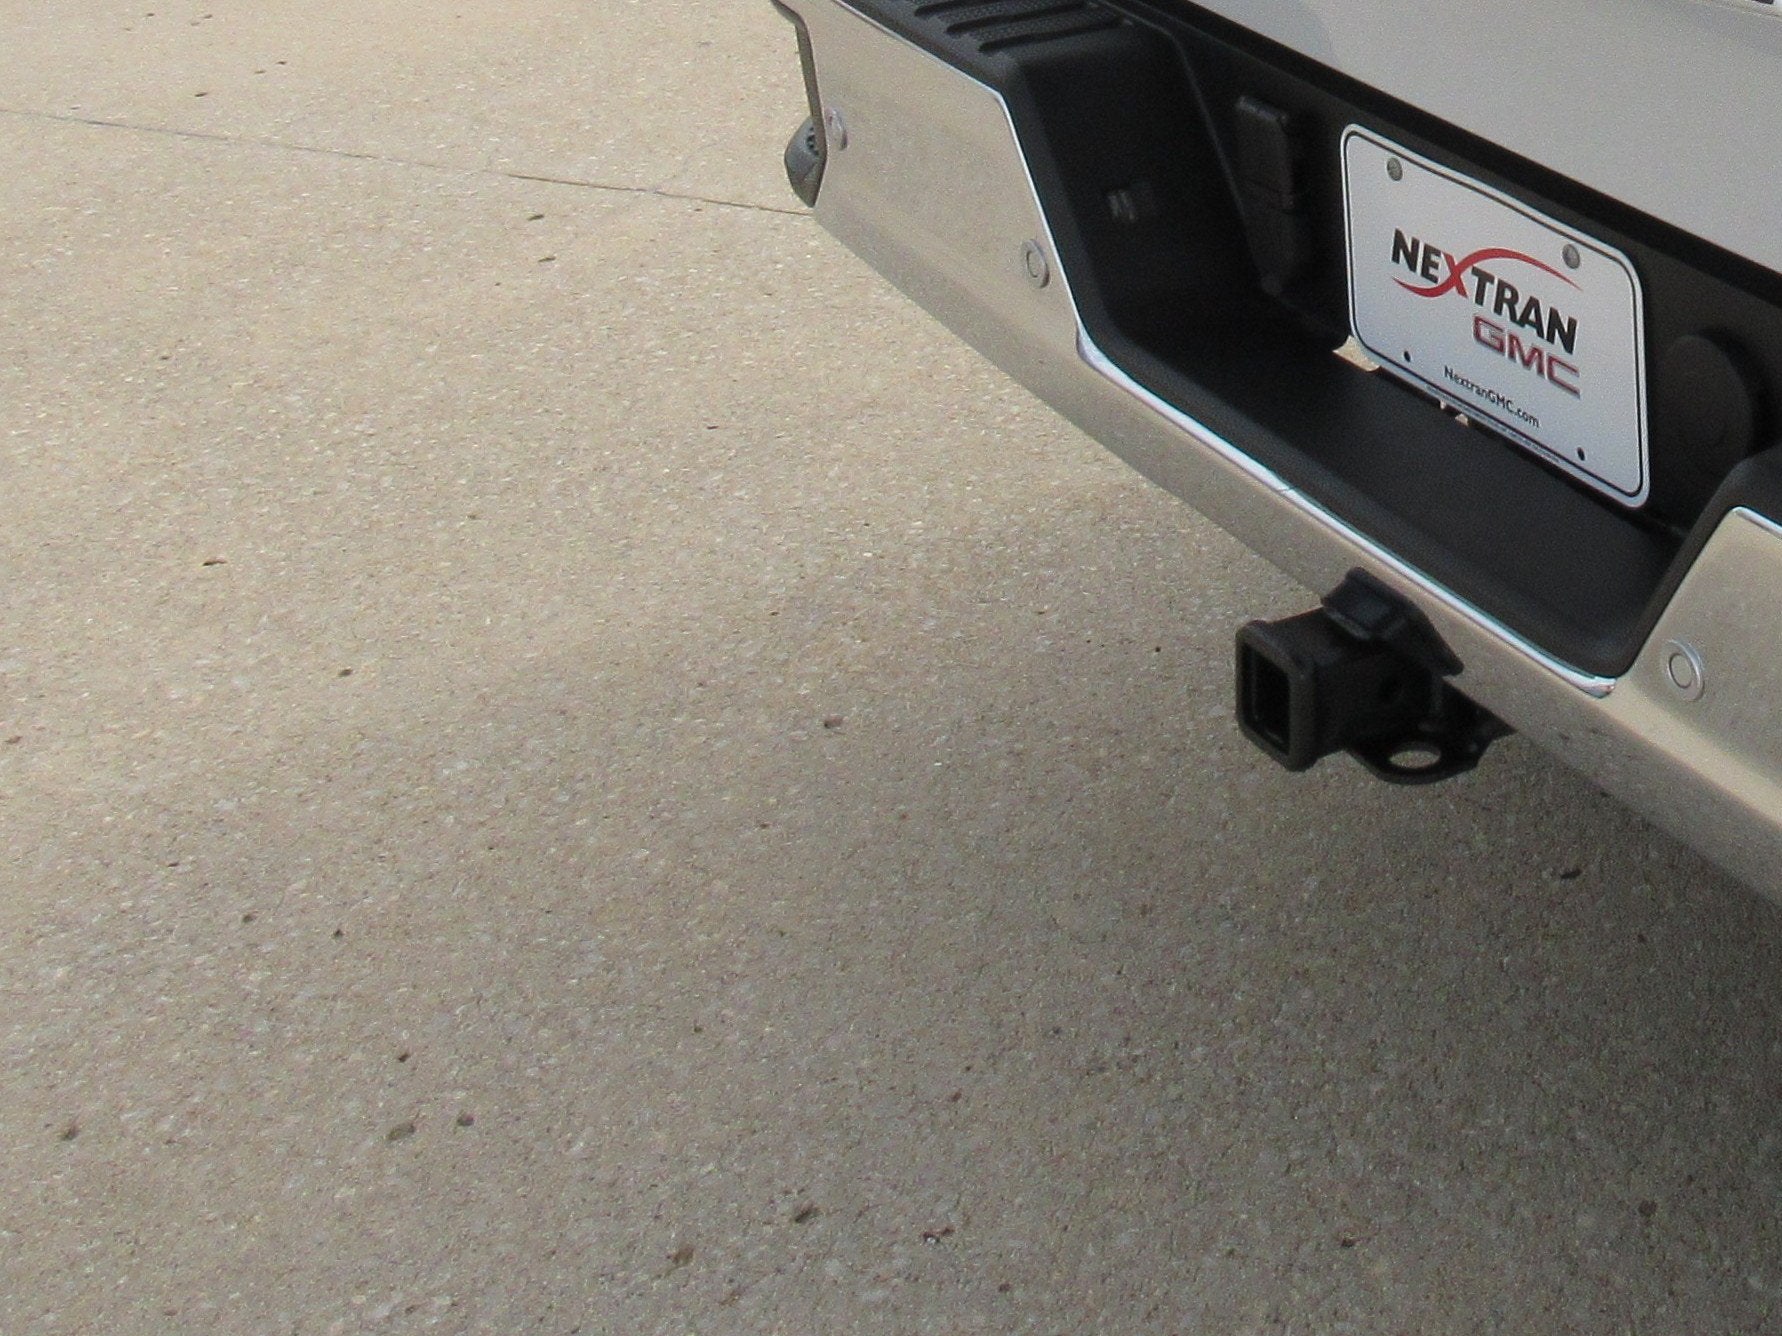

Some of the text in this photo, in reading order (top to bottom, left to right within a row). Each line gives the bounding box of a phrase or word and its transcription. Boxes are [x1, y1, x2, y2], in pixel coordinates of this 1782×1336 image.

[1391, 227, 1578, 355] NEXTRAN
[1443, 365, 1540, 428] NextranGMC.com
[1473, 315, 1581, 398] GMC
